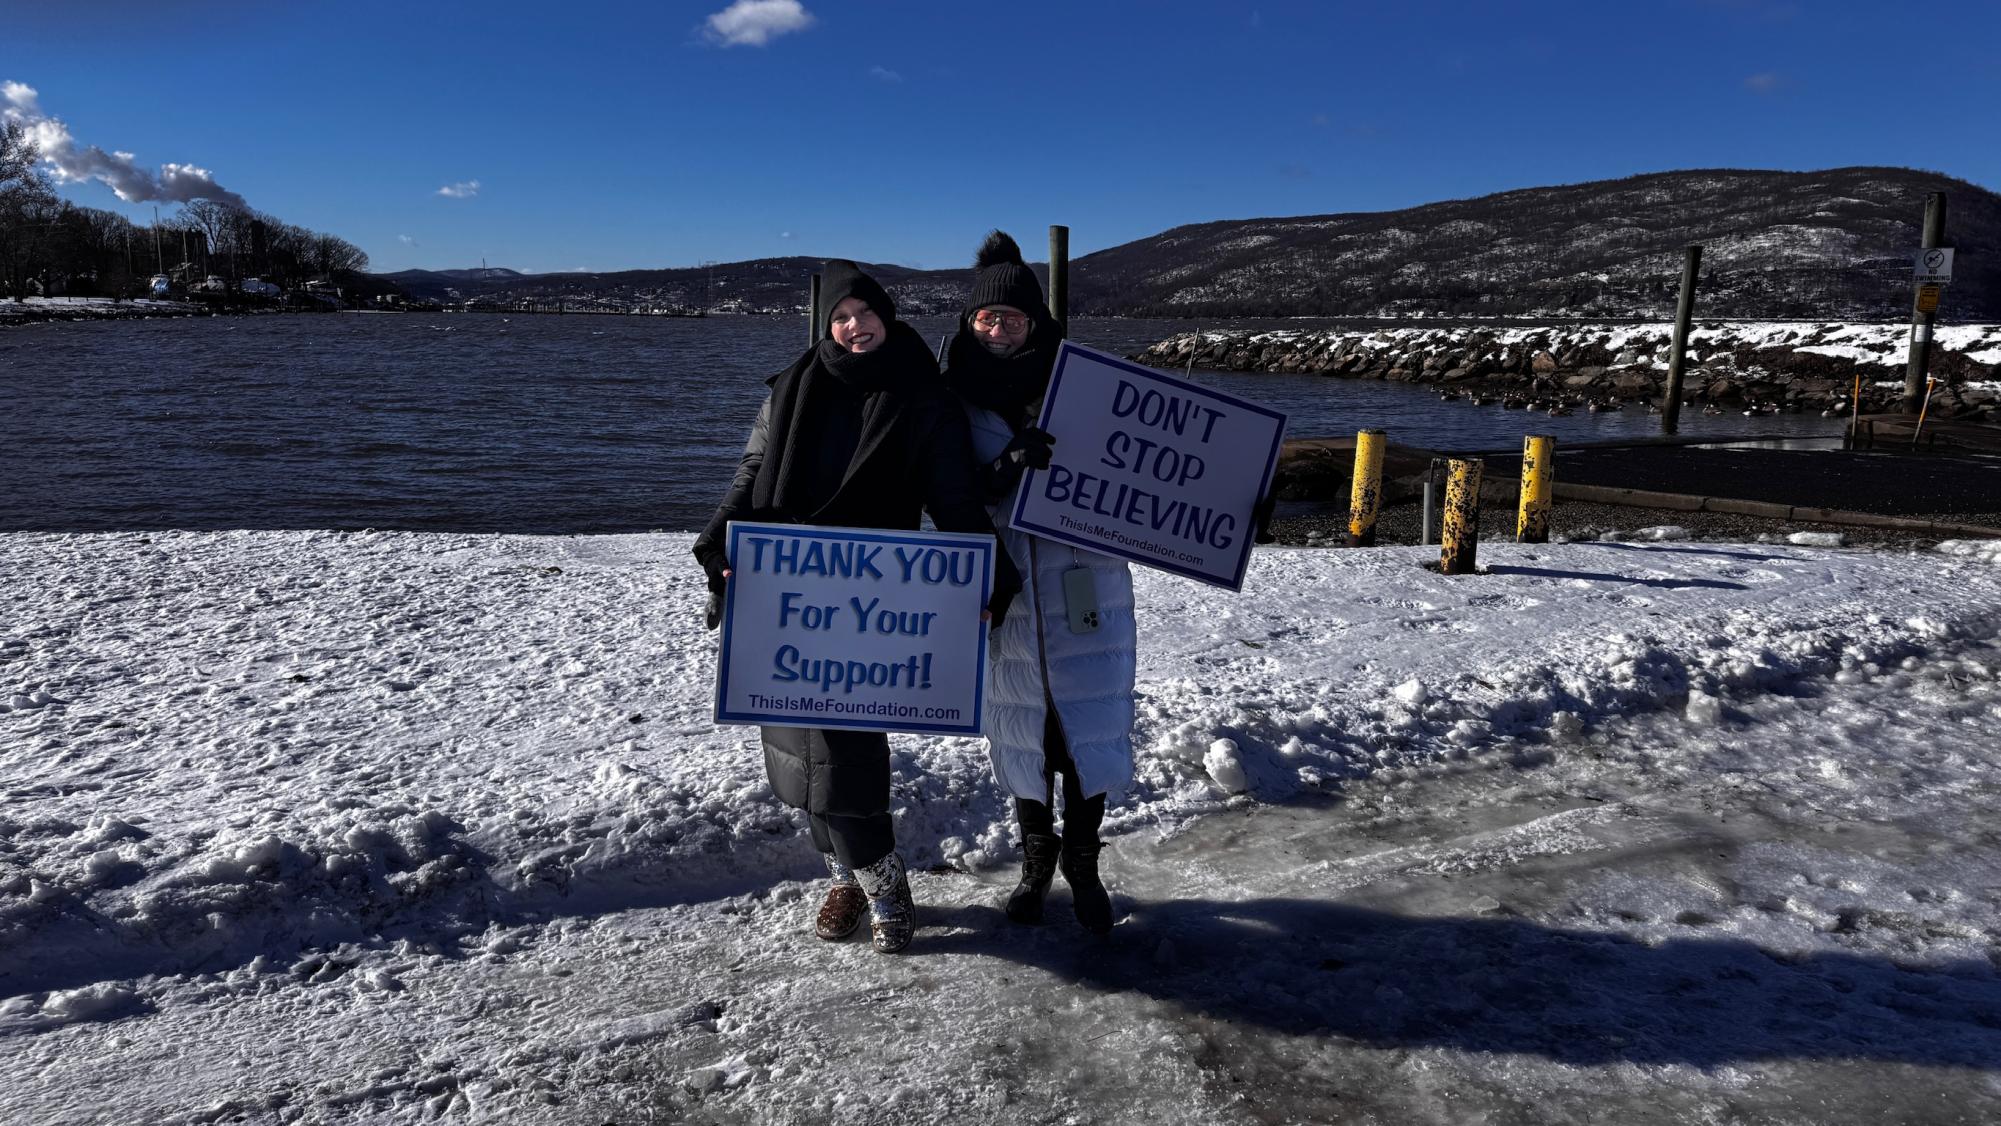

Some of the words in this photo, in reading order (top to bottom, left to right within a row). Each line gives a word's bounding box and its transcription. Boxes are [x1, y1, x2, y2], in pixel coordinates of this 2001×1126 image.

[1112, 379, 1227, 443] DON'T
[1100, 430, 1205, 487] STOP
[1044, 464, 1236, 550] BELIEVING
[747, 537, 883, 580] THANK
[895, 545, 975, 585] YOU
[1059, 514, 1204, 566] ThisIsMeFoundation.com
[779, 591, 840, 630] For
[849, 596, 937, 636] Your
[771, 644, 933, 694] Support!
[748, 694, 961, 721] ThisIsMeFoundation.com
